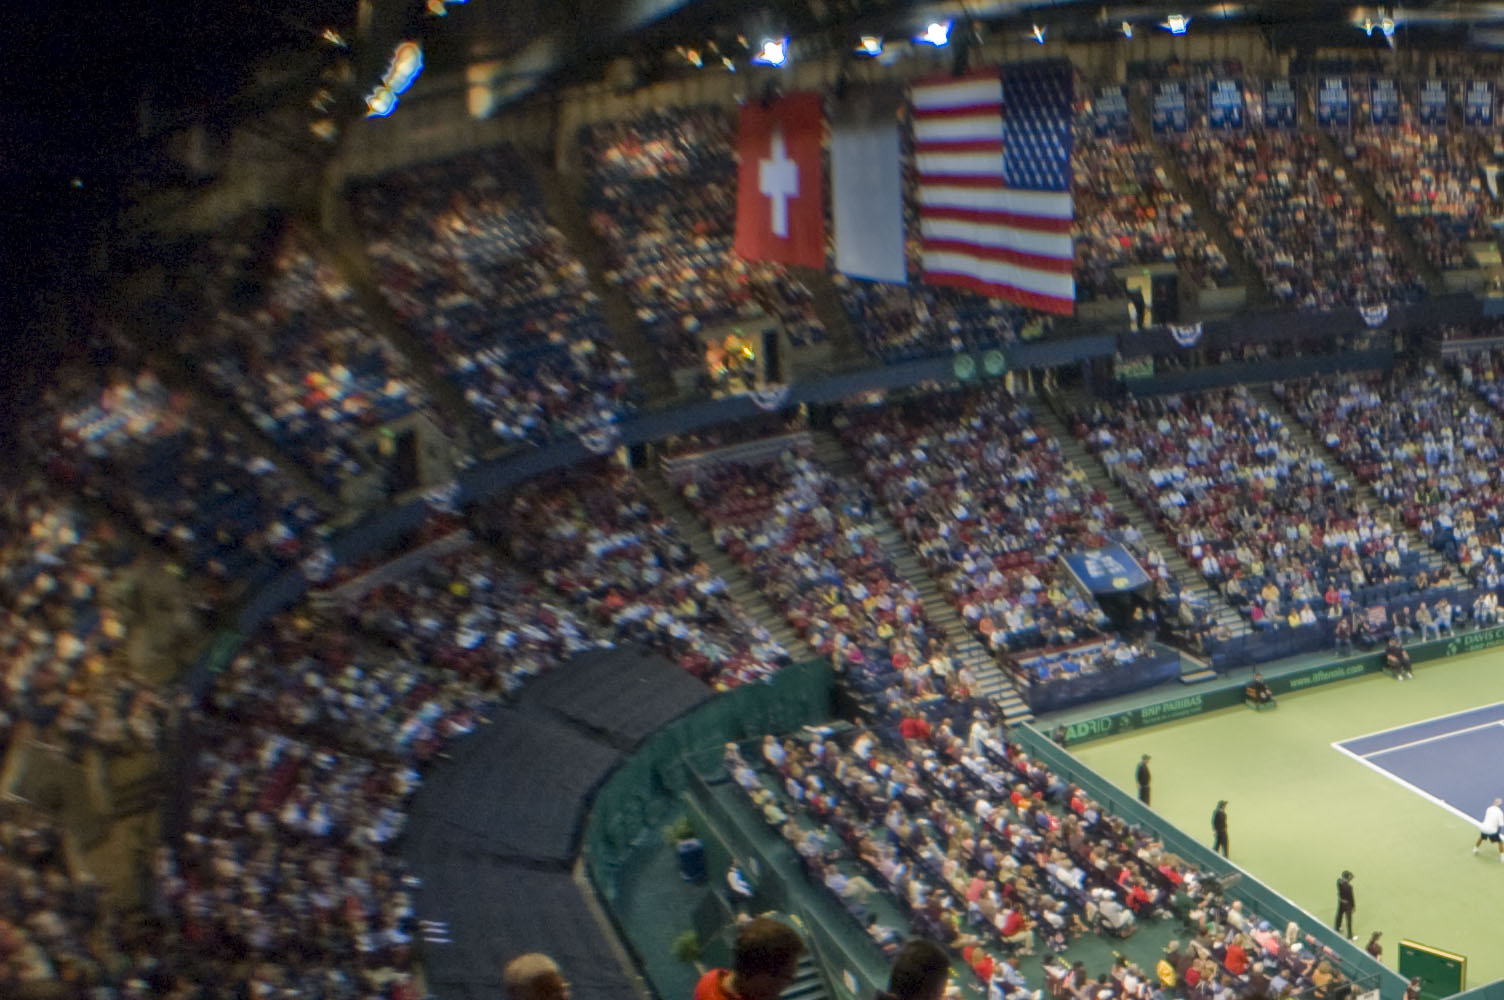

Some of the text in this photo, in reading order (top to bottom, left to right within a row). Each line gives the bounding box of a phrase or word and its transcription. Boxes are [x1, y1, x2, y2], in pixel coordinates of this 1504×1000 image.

[1464, 629, 1495, 646] DAVIS
[1141, 703, 1161, 718] BNP
[1163, 695, 1202, 713] PARIBAS
[1065, 717, 1112, 741] ADRID
